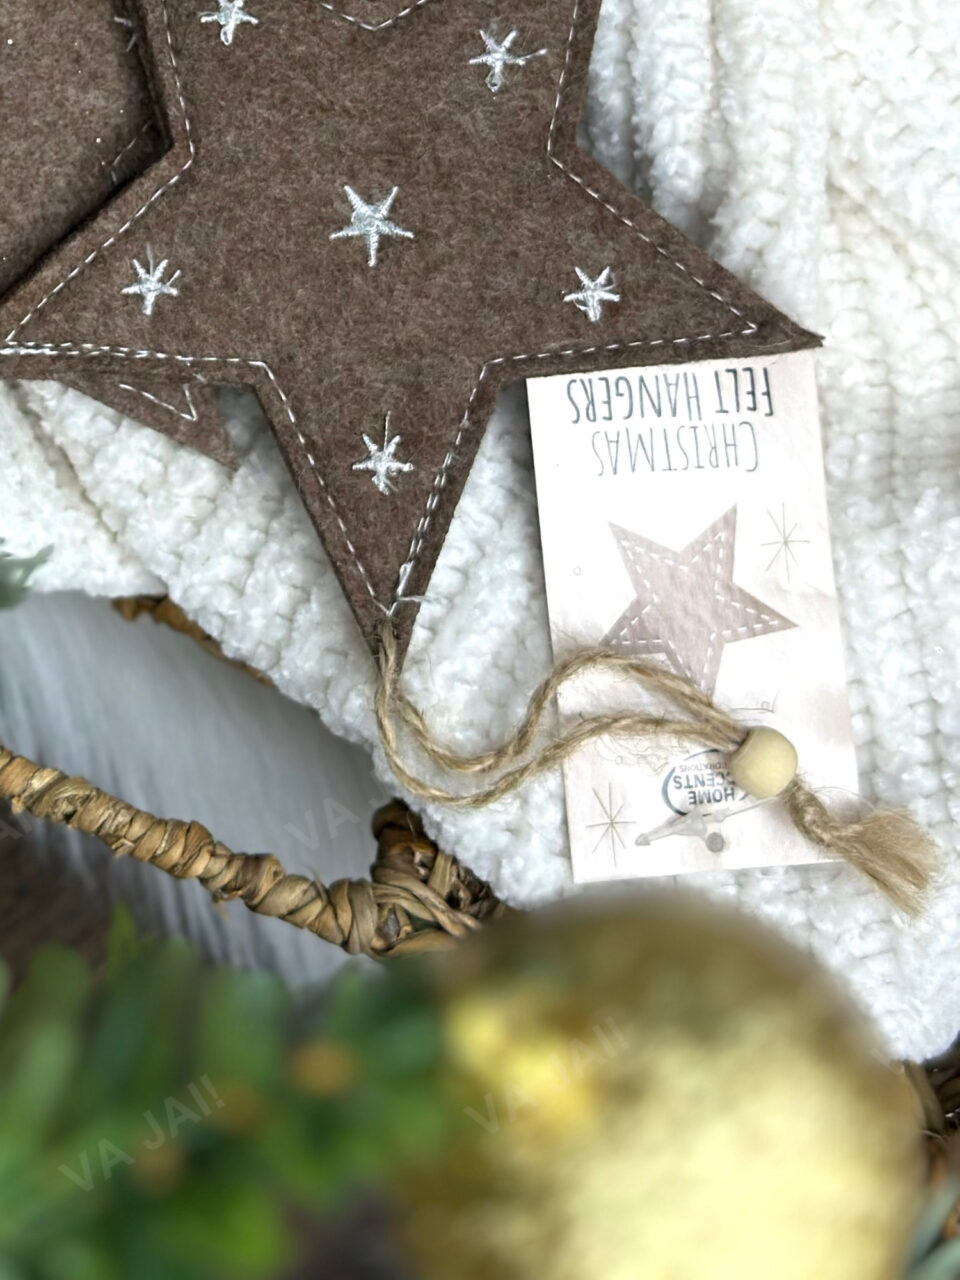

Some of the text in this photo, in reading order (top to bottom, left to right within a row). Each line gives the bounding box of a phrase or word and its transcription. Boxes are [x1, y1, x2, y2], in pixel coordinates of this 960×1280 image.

[567, 367, 774, 424] FELT HANGERS
[591, 421, 758, 477] CHRISTMAS
[673, 771, 735, 790] CENTS
[688, 787, 735, 806] HOME
